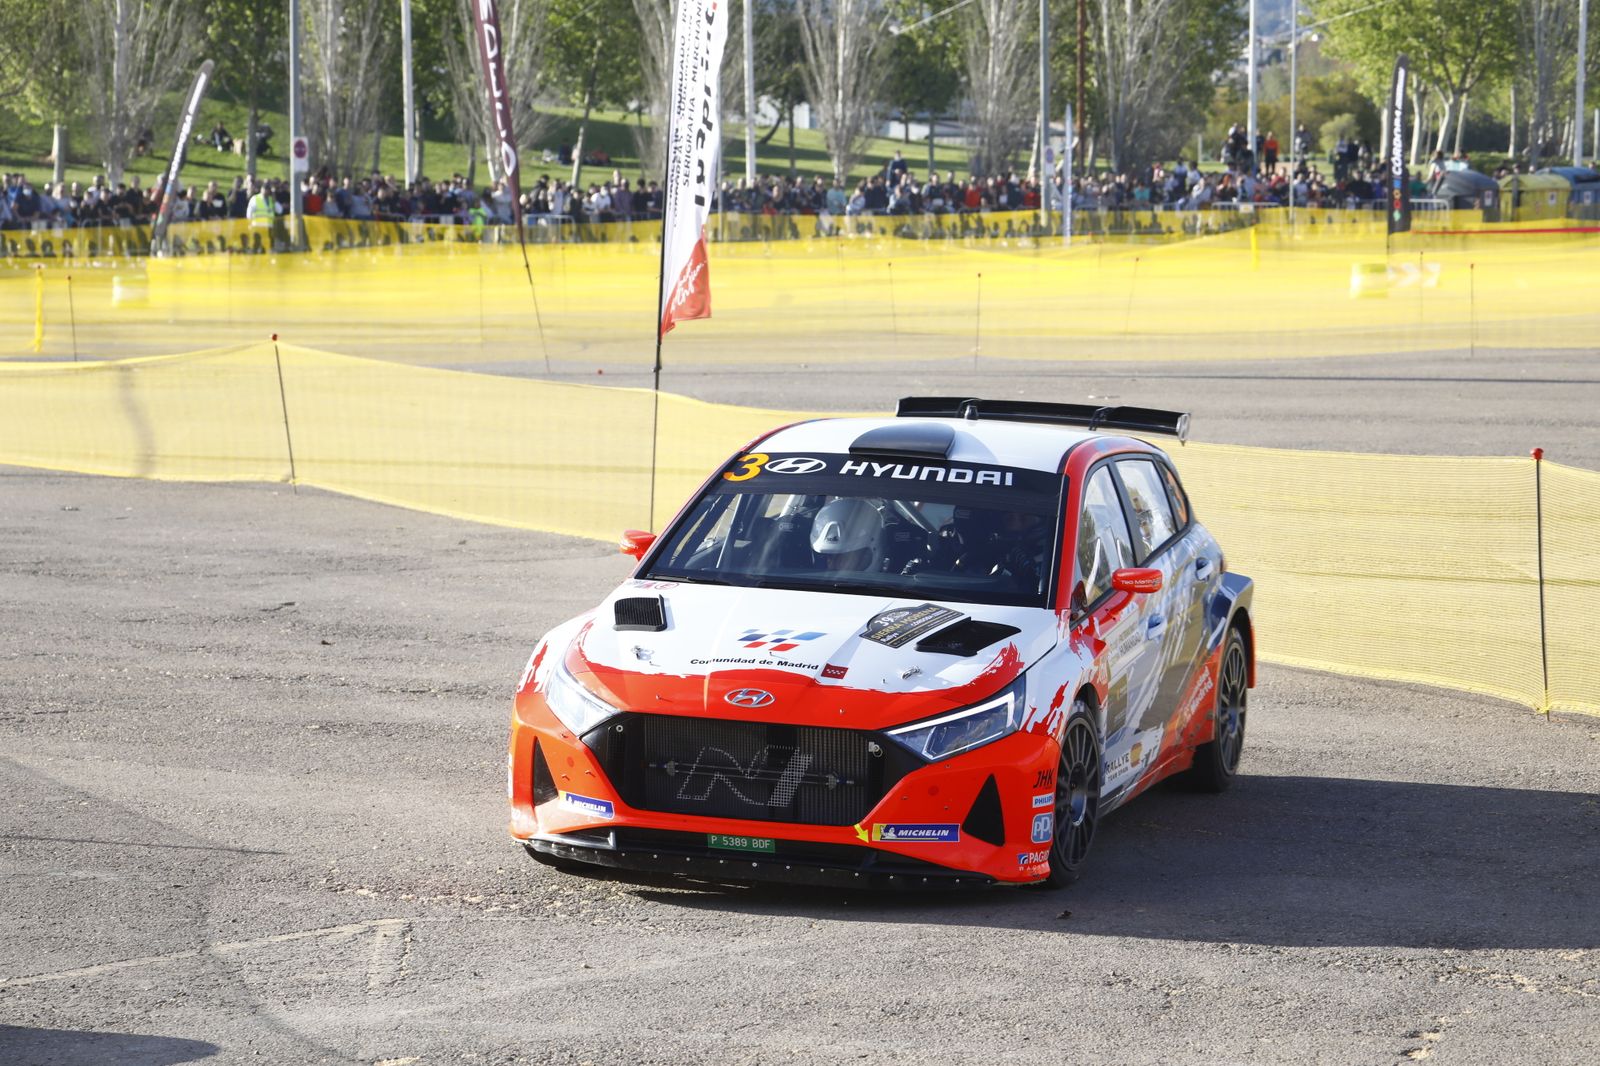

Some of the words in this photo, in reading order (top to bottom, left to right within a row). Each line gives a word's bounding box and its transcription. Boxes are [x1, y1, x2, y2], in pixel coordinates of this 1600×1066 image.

[723, 453, 769, 482] 3
[839, 460, 1013, 486] HYUNDAI
[758, 658, 773, 666] de
[777, 660, 819, 670] Madrid
[1033, 768, 1054, 788] JHK
[573, 800, 607, 812] MICHELIN
[898, 829, 949, 837] MICHELIN
[711, 835, 718, 845] P
[722, 836, 748, 847] 5389
[752, 838, 771, 849] BDF
